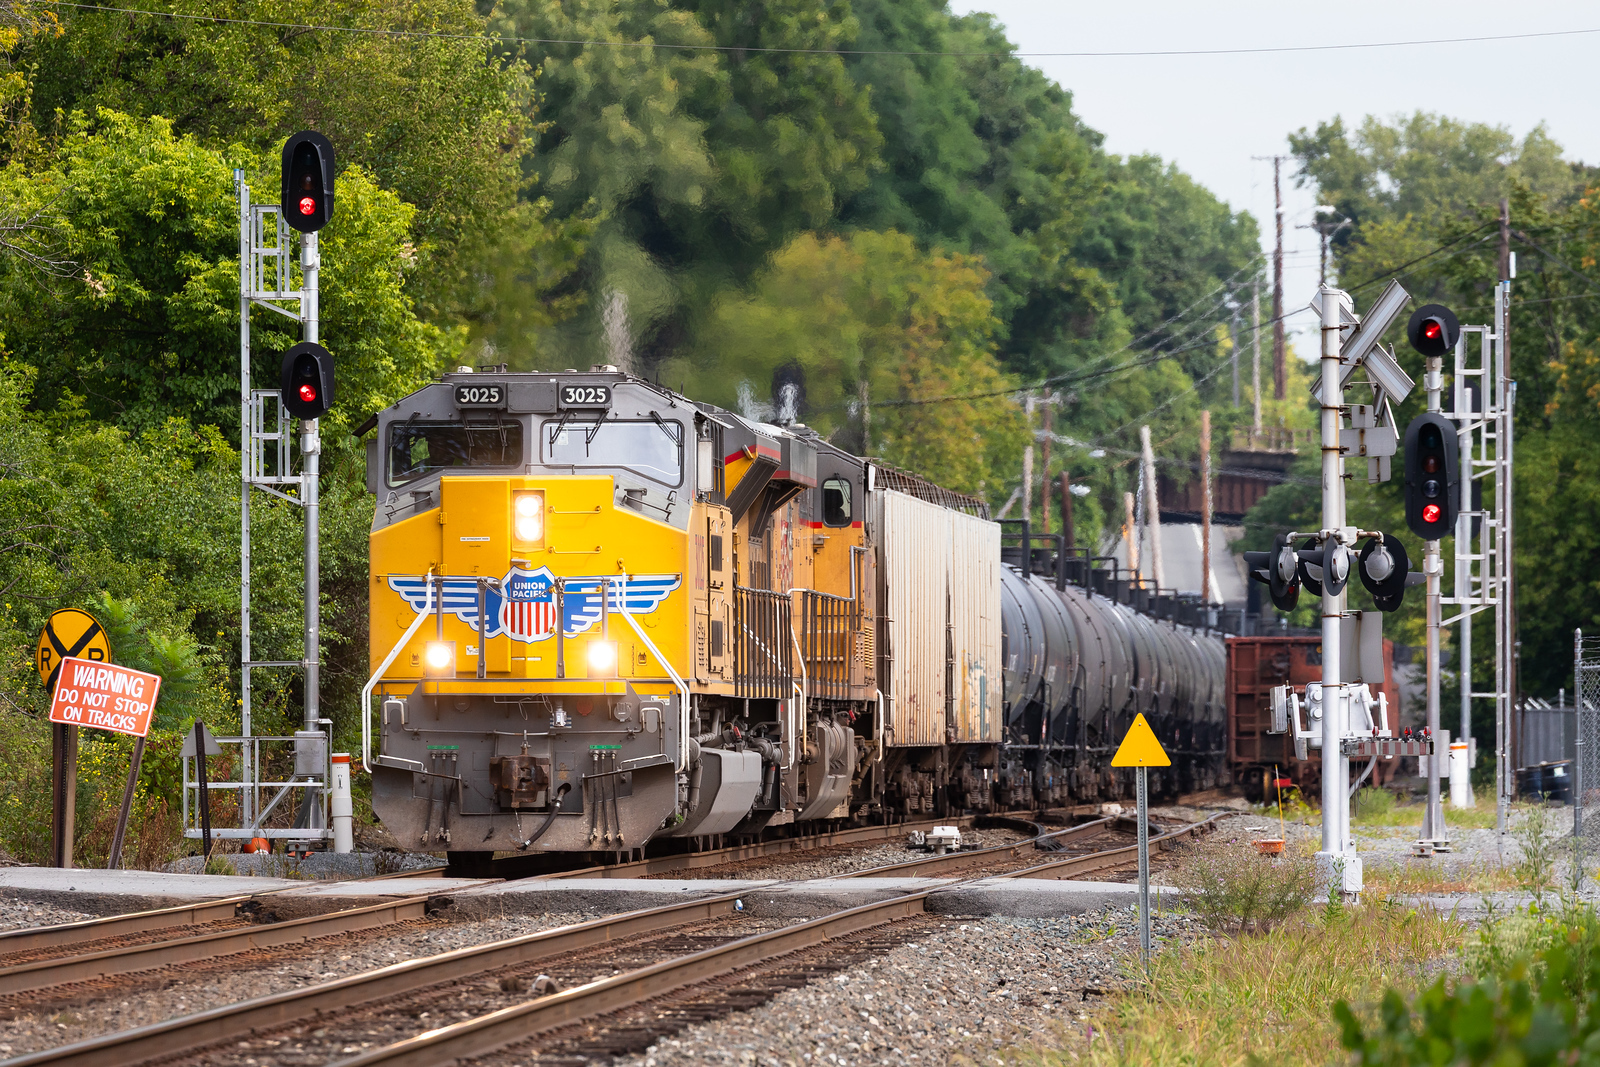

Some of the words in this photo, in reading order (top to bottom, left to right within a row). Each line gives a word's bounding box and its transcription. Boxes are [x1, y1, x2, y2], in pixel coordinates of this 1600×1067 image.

[460, 388, 499, 403] 3025
[566, 388, 606, 403] 3025
[514, 582, 546, 590] UNION
[73, 665, 144, 698] WARNING
[58, 688, 79, 703] DO
[82, 691, 110, 708] NOT
[114, 697, 148, 715] STOP
[63, 706, 83, 721] ON
[88, 709, 136, 730] TRACKS
